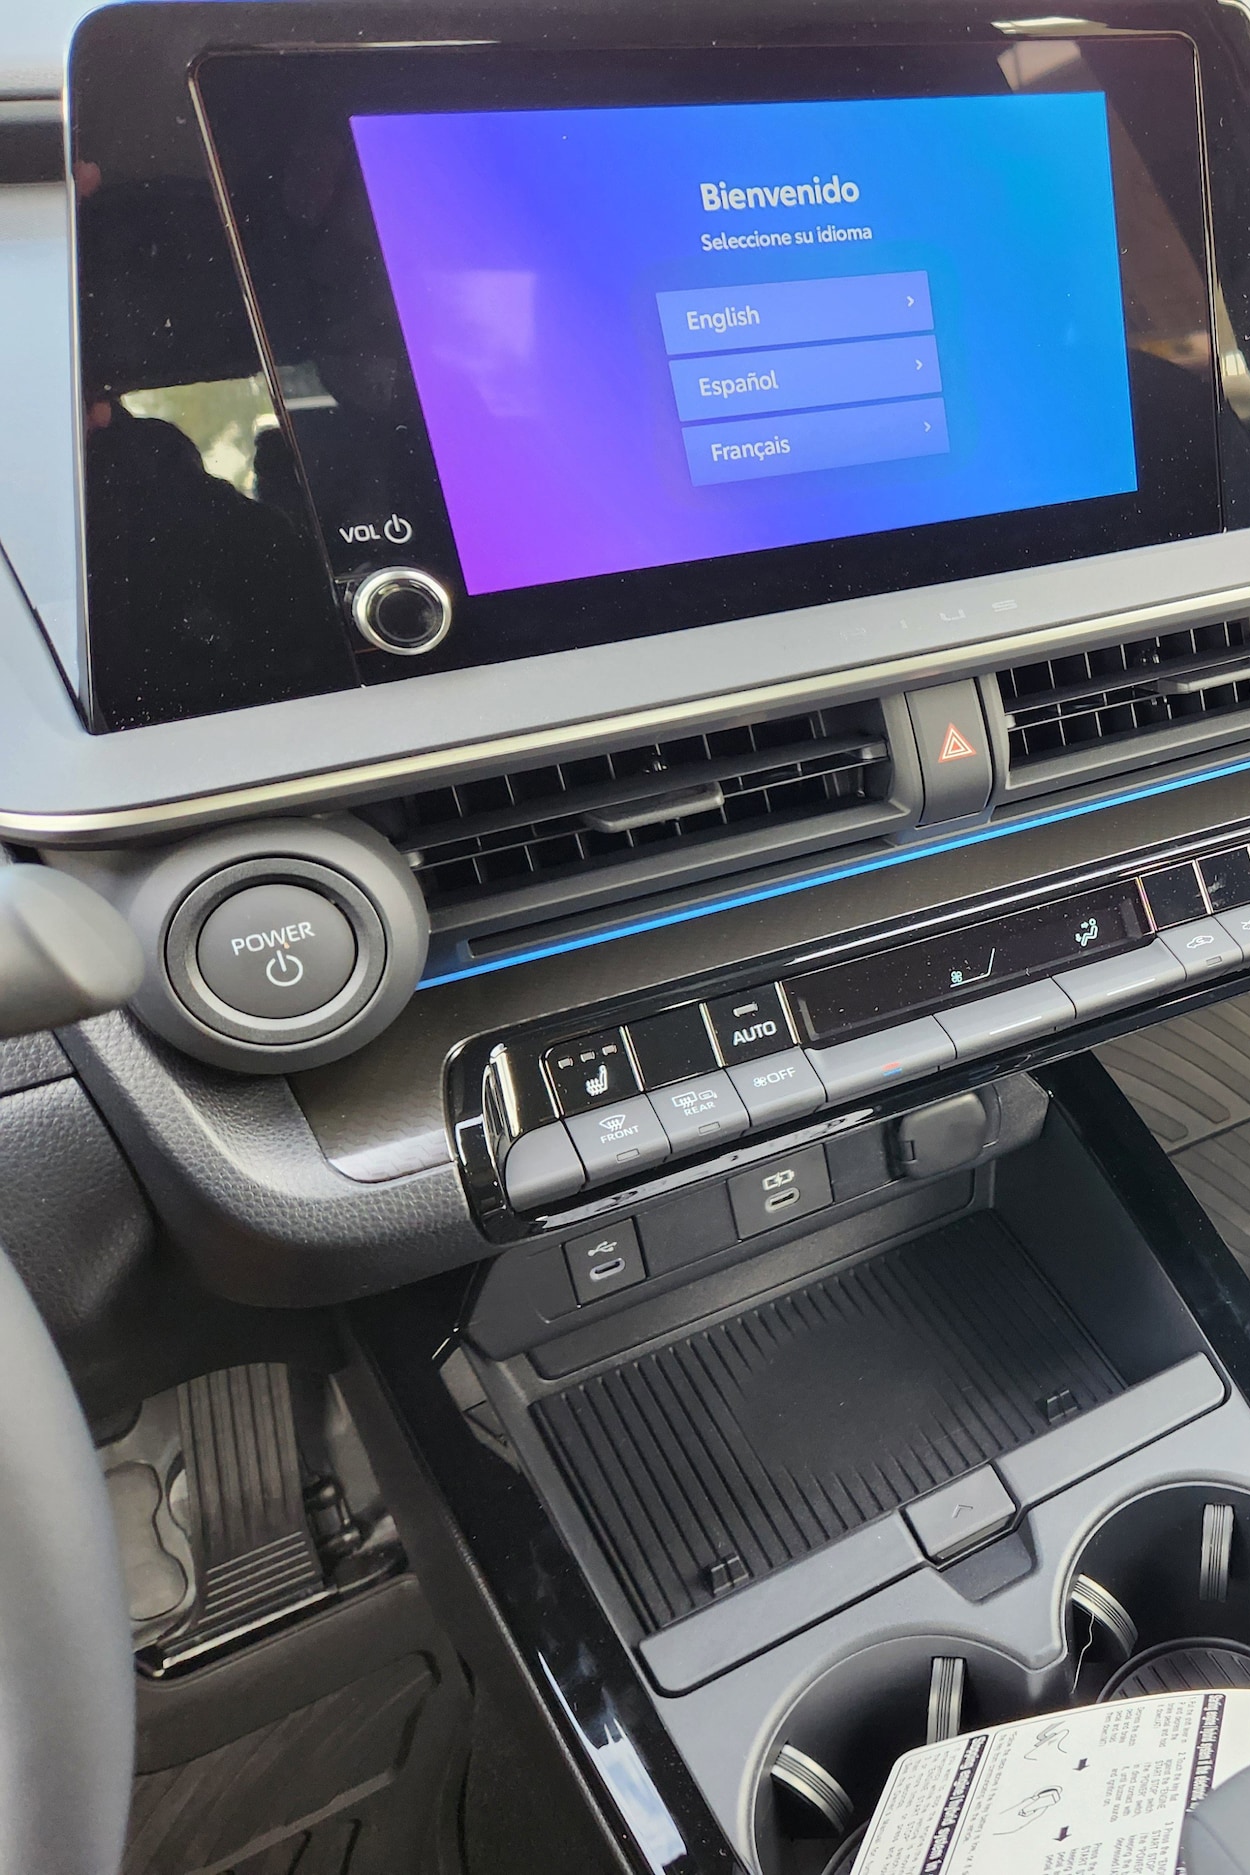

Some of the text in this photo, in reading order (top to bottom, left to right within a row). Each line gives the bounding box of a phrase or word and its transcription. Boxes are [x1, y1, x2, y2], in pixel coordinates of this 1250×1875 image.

[700, 174, 860, 212] Bienvenido
[700, 225, 873, 252] Seleccione su idioma
[686, 305, 761, 334] English
[699, 369, 779, 399] Español
[711, 435, 791, 462] Français
[338, 524, 381, 543] VOL
[231, 921, 316, 956] POWER
[732, 1020, 778, 1046] AUTO
[766, 1066, 797, 1085] OFF
[684, 1101, 716, 1117] REAR
[599, 1124, 640, 1145] FRONT
[959, 1735, 986, 1770] Stopping
[928, 1827, 950, 1860] system
[924, 1859, 942, 1873] in
